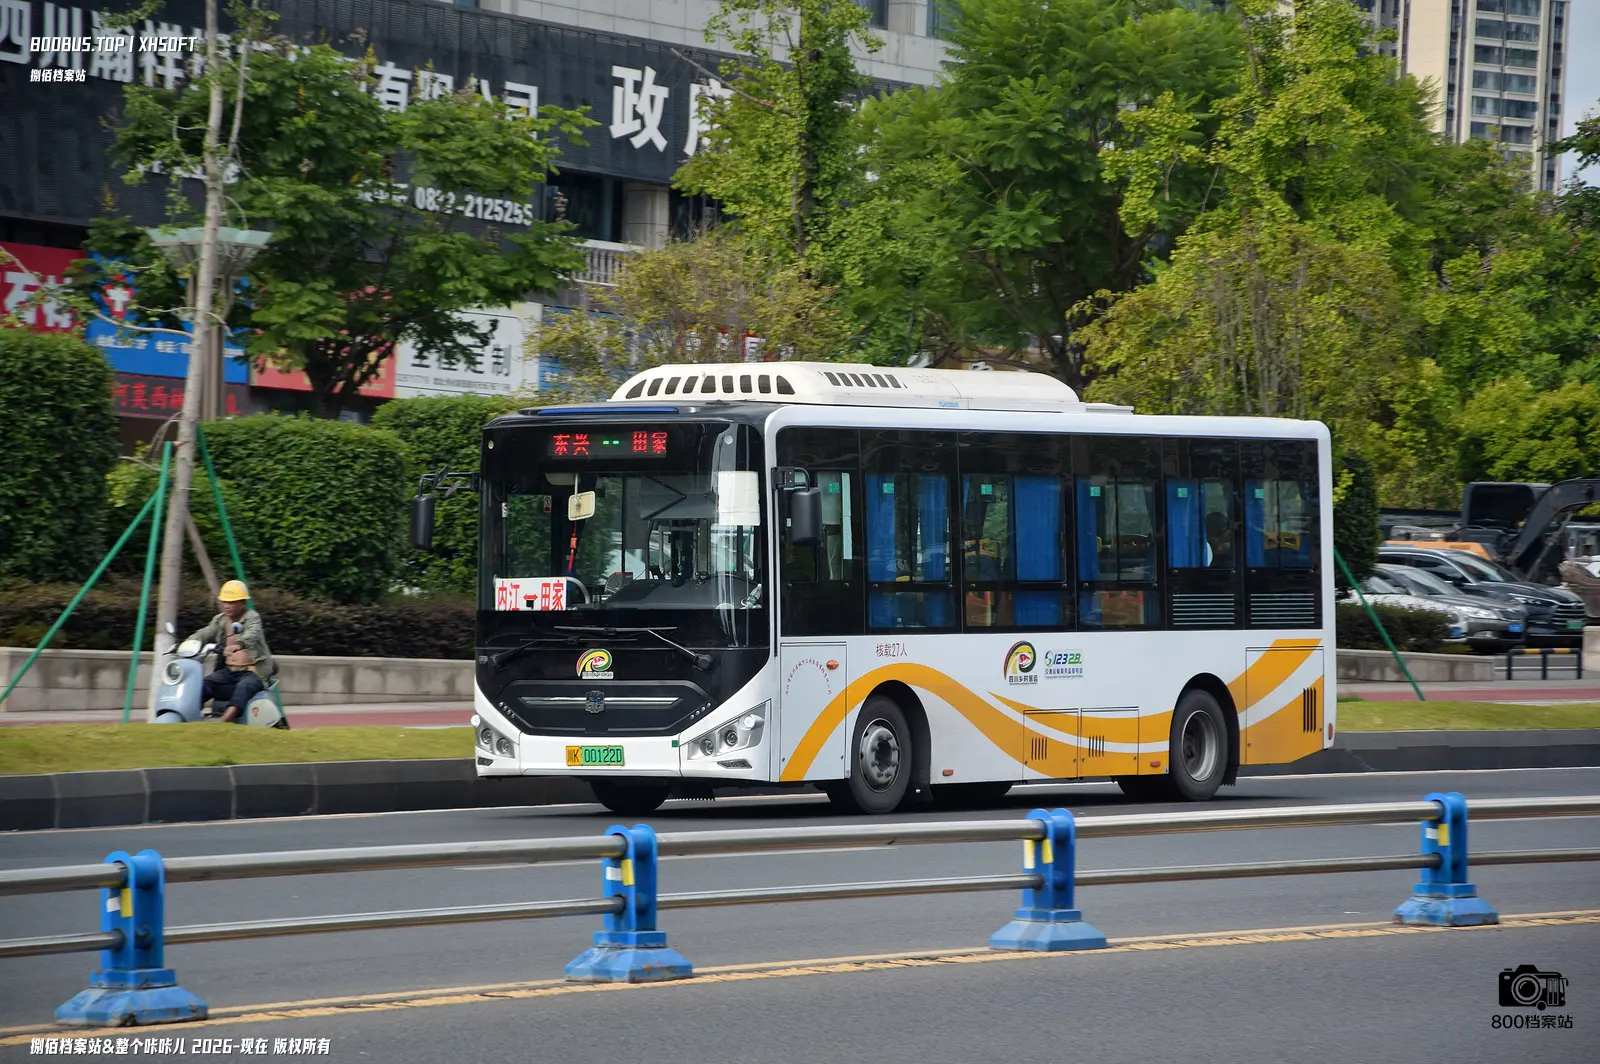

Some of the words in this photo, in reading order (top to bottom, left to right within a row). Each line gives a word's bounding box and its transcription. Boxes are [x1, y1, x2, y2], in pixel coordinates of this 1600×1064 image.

[497, 580, 520, 611] 内江
[540, 579, 564, 611] 田家
[875, 642, 908, 657] 核载27人
